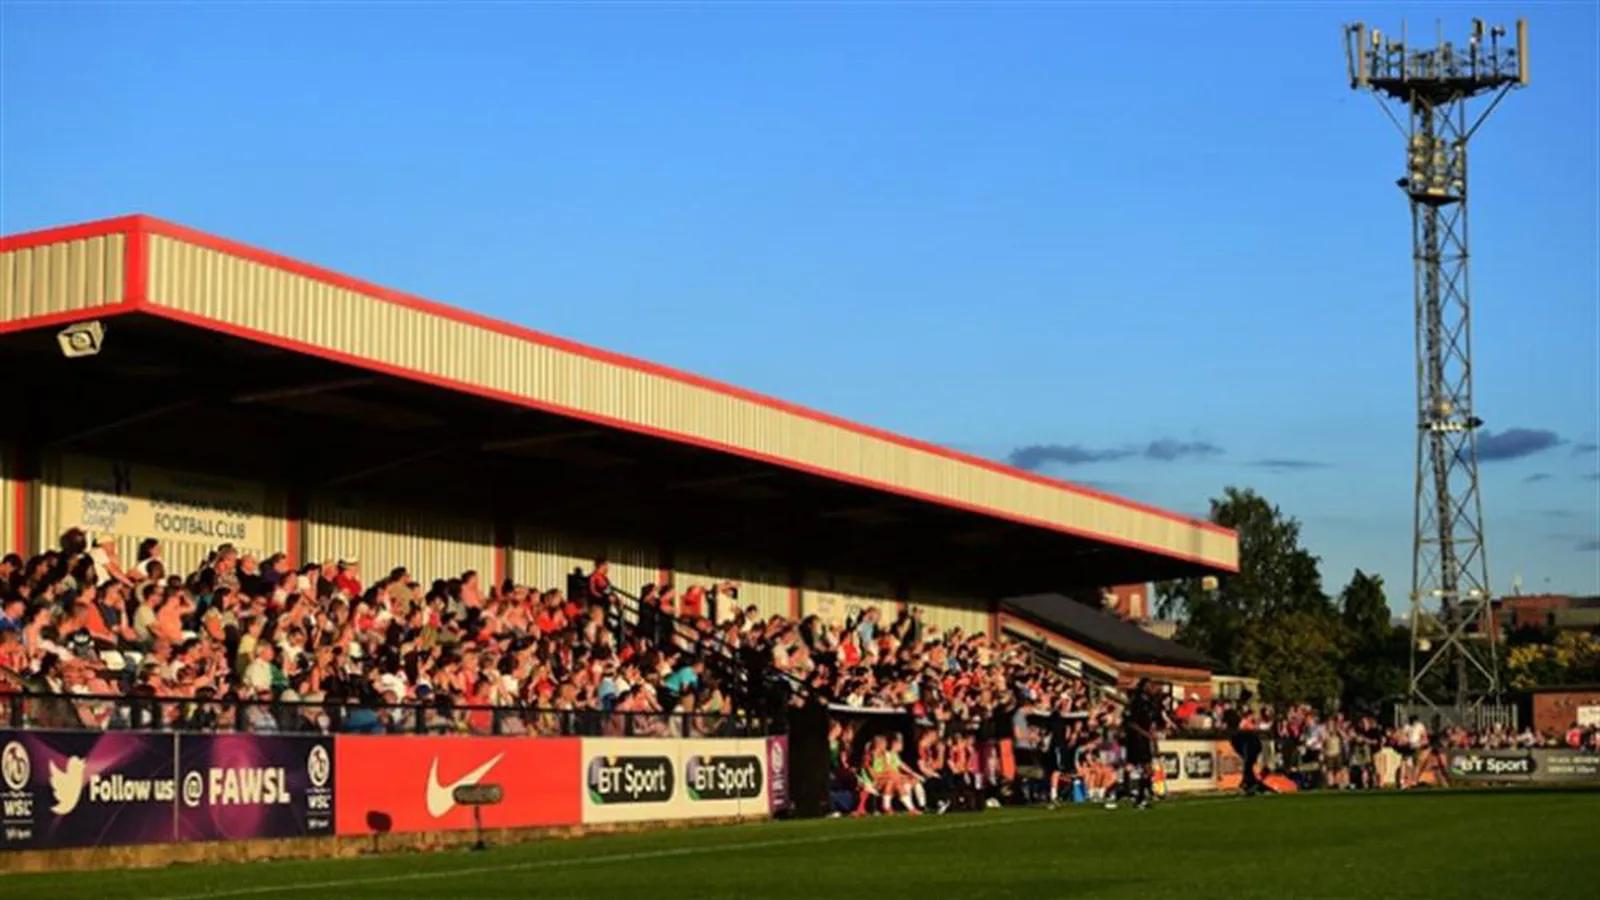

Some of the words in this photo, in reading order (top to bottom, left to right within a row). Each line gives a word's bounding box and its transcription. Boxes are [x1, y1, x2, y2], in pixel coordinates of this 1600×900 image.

[154, 512, 214, 537] FOOTBALL
[215, 519, 246, 540] CLUB
[598, 767, 622, 794] BT
[624, 763, 666, 798] Sport
[694, 766, 716, 791] BT
[718, 762, 755, 795] Sport
[1486, 757, 1528, 774] Sport
[90, 774, 150, 802] Follow
[154, 778, 175, 801] us
[208, 767, 290, 804] FAWSL
